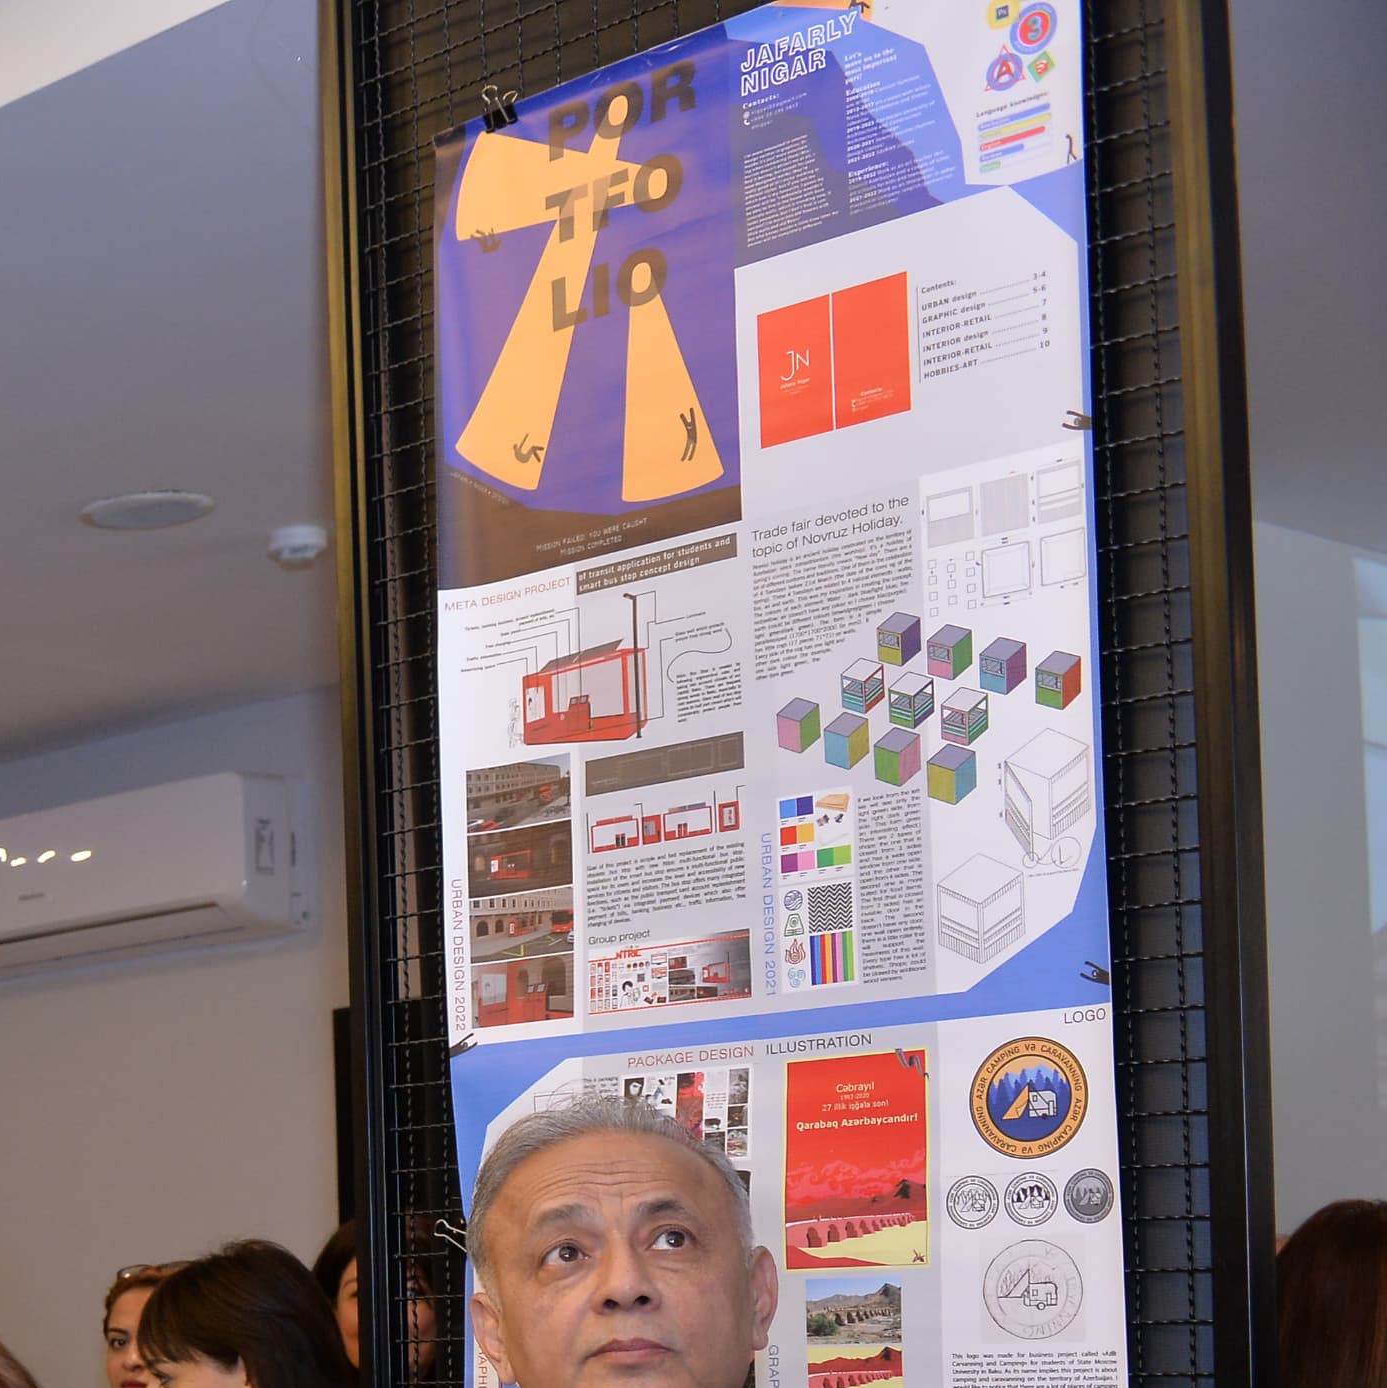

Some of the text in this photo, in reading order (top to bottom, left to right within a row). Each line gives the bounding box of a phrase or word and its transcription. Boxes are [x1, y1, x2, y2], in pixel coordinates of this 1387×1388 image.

[741, 11, 858, 73] JAFARLY
[741, 49, 826, 96] NIGAR
[546, 60, 696, 161] POR
[975, 104, 1008, 118] Language
[544, 152, 684, 242] TFO
[551, 246, 667, 331] LIO
[921, 279, 957, 294] Contents:
[921, 297, 950, 312] URBAN
[951, 290, 977, 304] design
[922, 307, 959, 325] GRAPHIC
[959, 300, 986, 316] design
[922, 298, 1047, 338] INTERIOR-RETAIL 7
[922, 313, 1047, 352] INTERIOR design 8
[923, 327, 1048, 366] INTERIOR-RETAIL 9
[780, 349, 810, 382] JN
[923, 339, 1051, 379] HOBBIES-ART 10
[751, 496, 909, 542] Trade fair devoted to the
[752, 514, 904, 560] topic of Novruz Holiday.
[578, 537, 731, 581] of transit application for students and
[578, 555, 700, 593] smart bus stop concept design
[444, 576, 572, 613] META DESIGN PROJECT
[761, 832, 776, 996] URBAN DESIGN 2021
[451, 879, 466, 1032] URBAN DESIGN 2022
[589, 929, 651, 945] Group project
[1063, 1007, 1107, 1024] LOGO
[627, 1046, 754, 1068] PACKAGE DESIGN
[765, 1033, 872, 1056] ILLUSTRATION
[796, 1118, 838, 1132] Qarabaq
[822, 1103, 832, 1112] 27
[872, 1099, 889, 1108] son!
